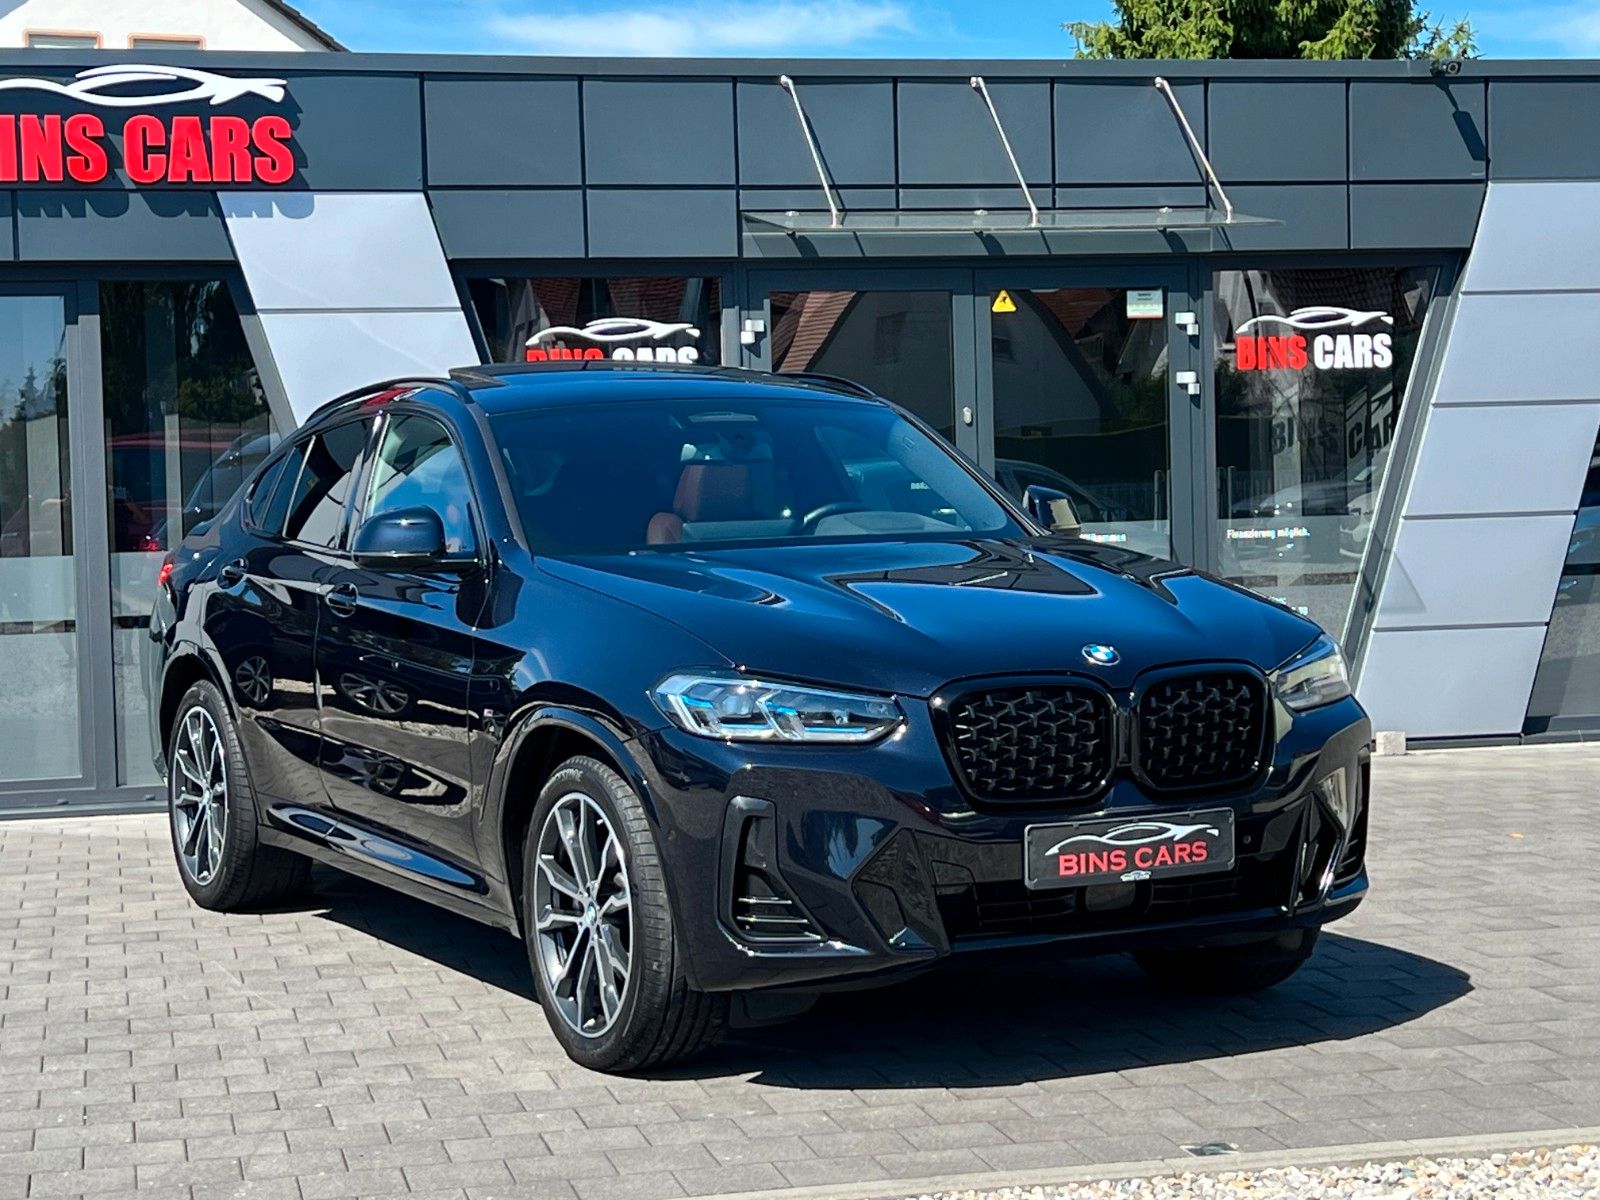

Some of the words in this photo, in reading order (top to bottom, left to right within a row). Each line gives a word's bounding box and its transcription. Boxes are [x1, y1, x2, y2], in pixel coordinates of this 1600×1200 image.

[0, 114, 108, 183] INS
[123, 114, 294, 183] CARS
[1236, 333, 1308, 371] BINS
[1313, 333, 1393, 370] CARS
[1058, 849, 1127, 876] BINS
[1134, 841, 1208, 870] CARS
